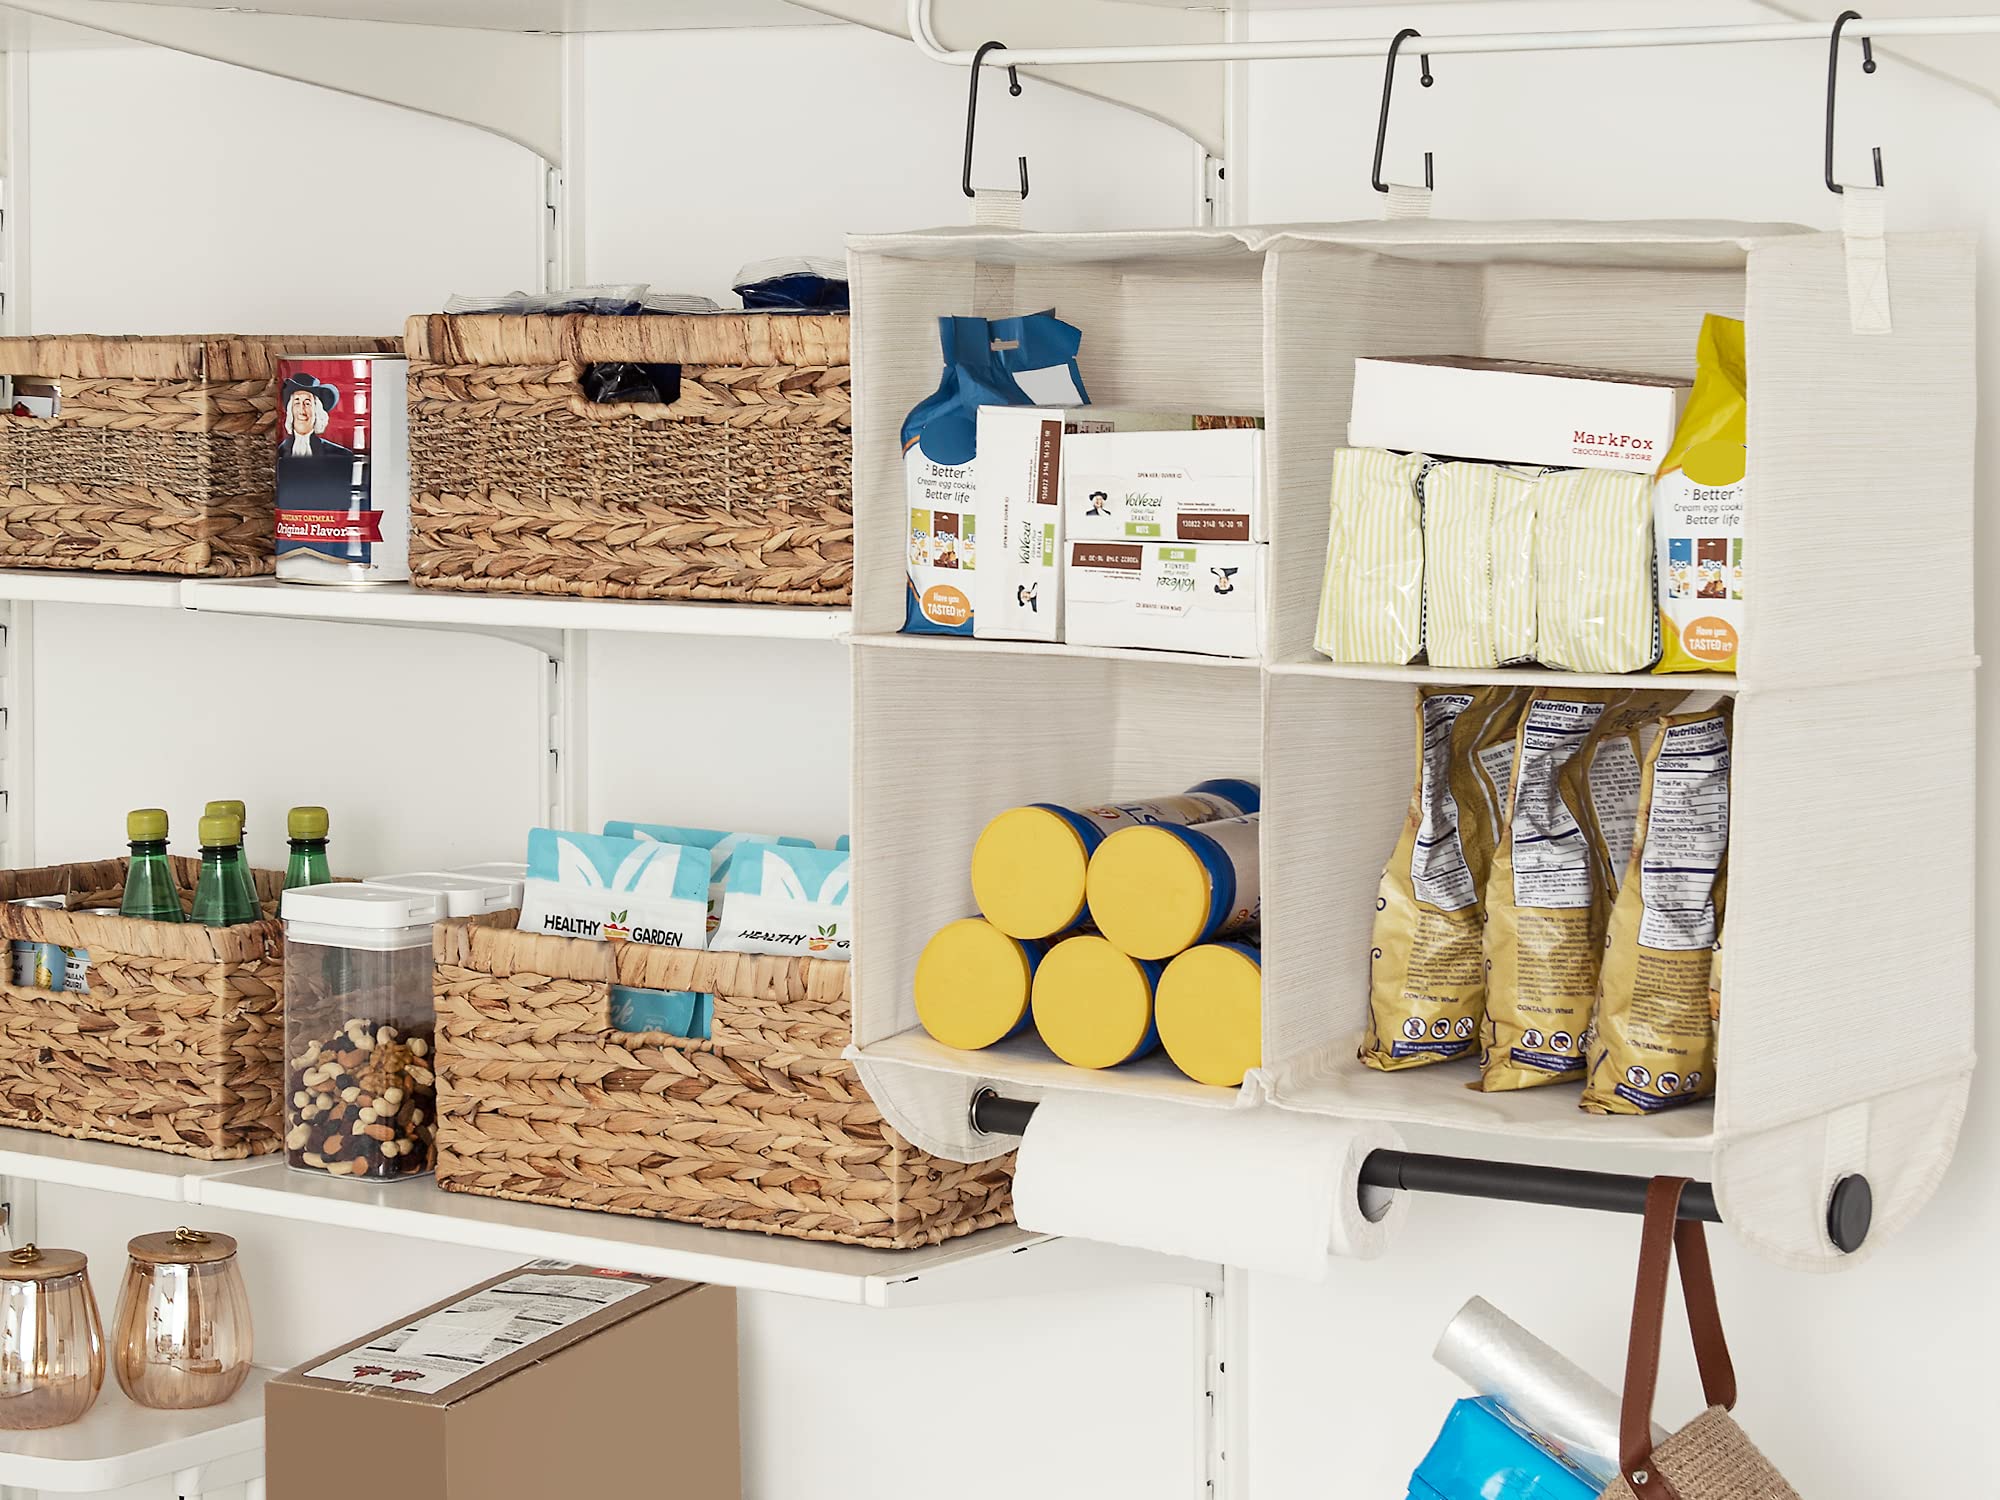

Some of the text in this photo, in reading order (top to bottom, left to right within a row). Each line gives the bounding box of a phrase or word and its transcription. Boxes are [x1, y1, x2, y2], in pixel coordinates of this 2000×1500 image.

[1573, 430, 1653, 450] MarkFox
[932, 464, 966, 478] Better
[917, 476, 937, 486] Cream
[939, 481, 952, 490] egg
[925, 488, 970, 503] Better life
[1125, 491, 1163, 507] VolVezel
[1692, 488, 1735, 501] Better
[1674, 503, 1701, 511] Cream
[1703, 504, 1718, 513] egg
[303, 515, 335, 523] OATMEAL
[1686, 513, 1740, 527] Better life
[277, 522, 347, 537] Original Flavor
[1019, 521, 1031, 564] VolVezel
[1156, 576, 1195, 593] VolVezel
[927, 603, 955, 617] TASTED
[1689, 638, 1722, 651] TASTED
[1532, 701, 1578, 713] Nutrition
[1667, 725, 1706, 738] Nutrition
[544, 914, 683, 947] HEALTHY GARDEN
[738, 930, 807, 946] HEALTHY
